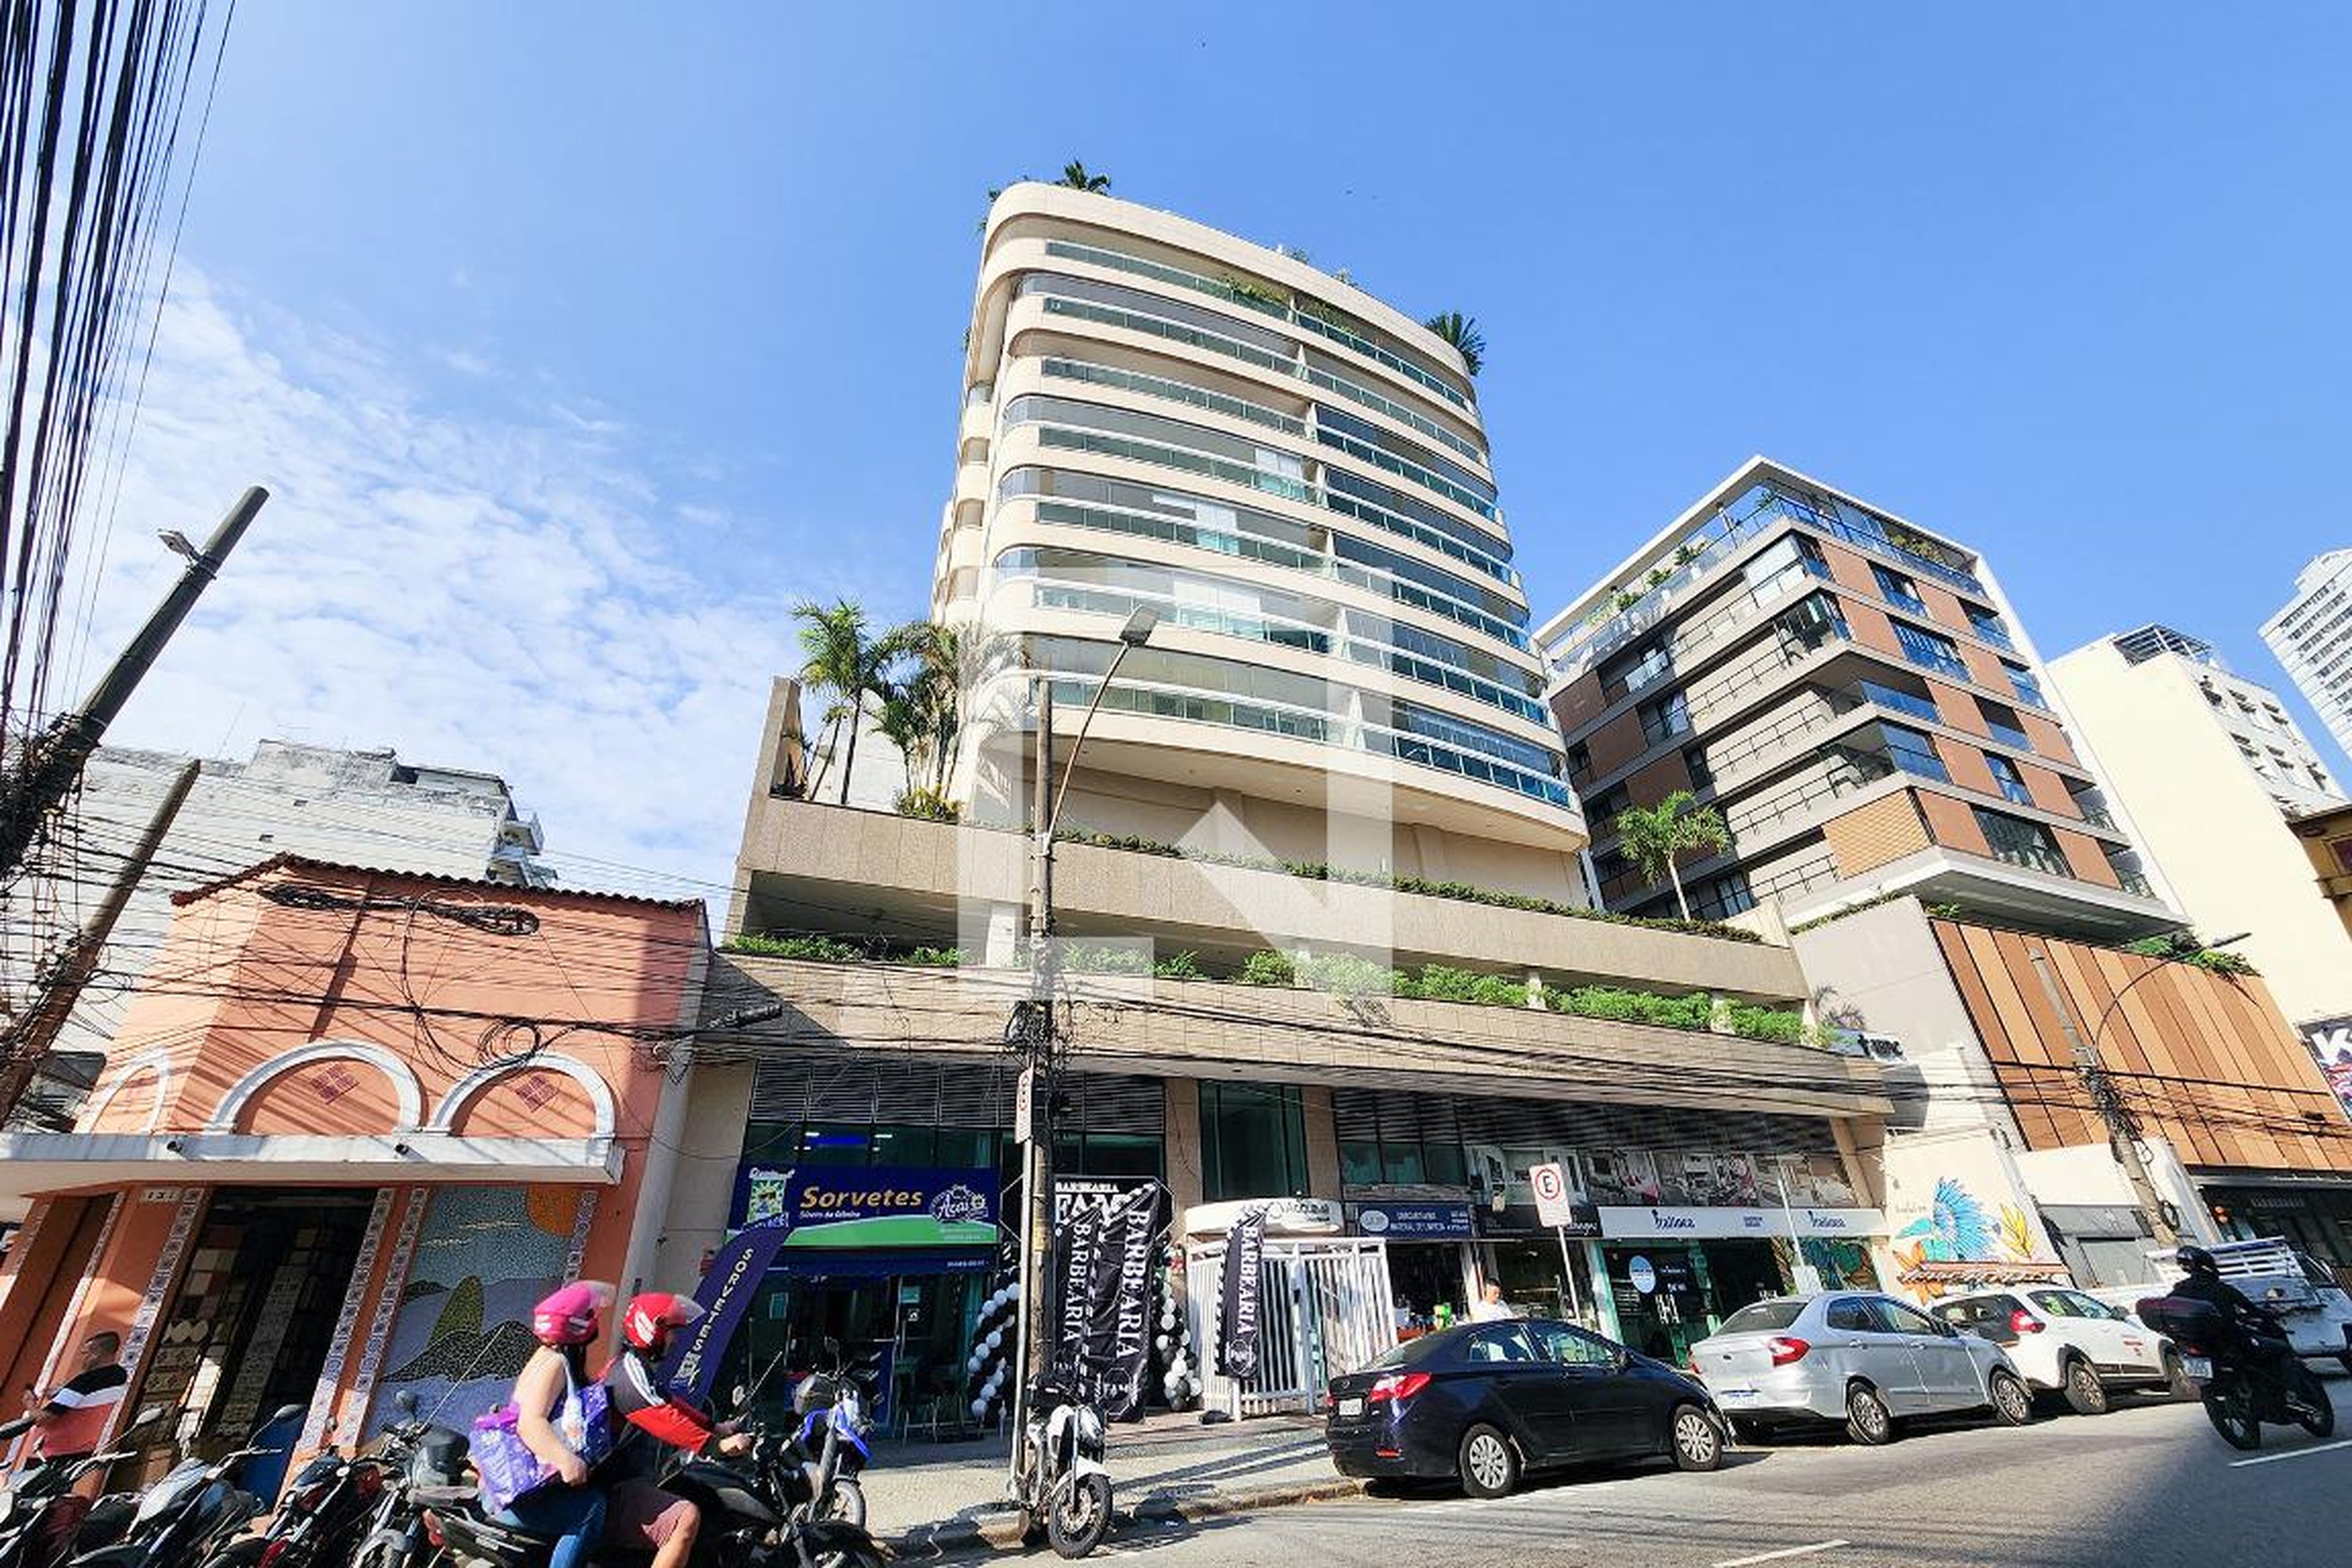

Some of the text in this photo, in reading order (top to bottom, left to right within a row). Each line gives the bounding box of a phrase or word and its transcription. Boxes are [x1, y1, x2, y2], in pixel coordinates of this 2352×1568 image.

[800, 1186, 923, 1208] Sorvetes
[1543, 1175, 1553, 1193] E
[693, 1248, 754, 1351] SORVETES
[1063, 1224, 1091, 1342] BARBEARIA
[1117, 1210, 1150, 1358] BARBEARIA
[1237, 1225, 1258, 1334] BARBEARIA
